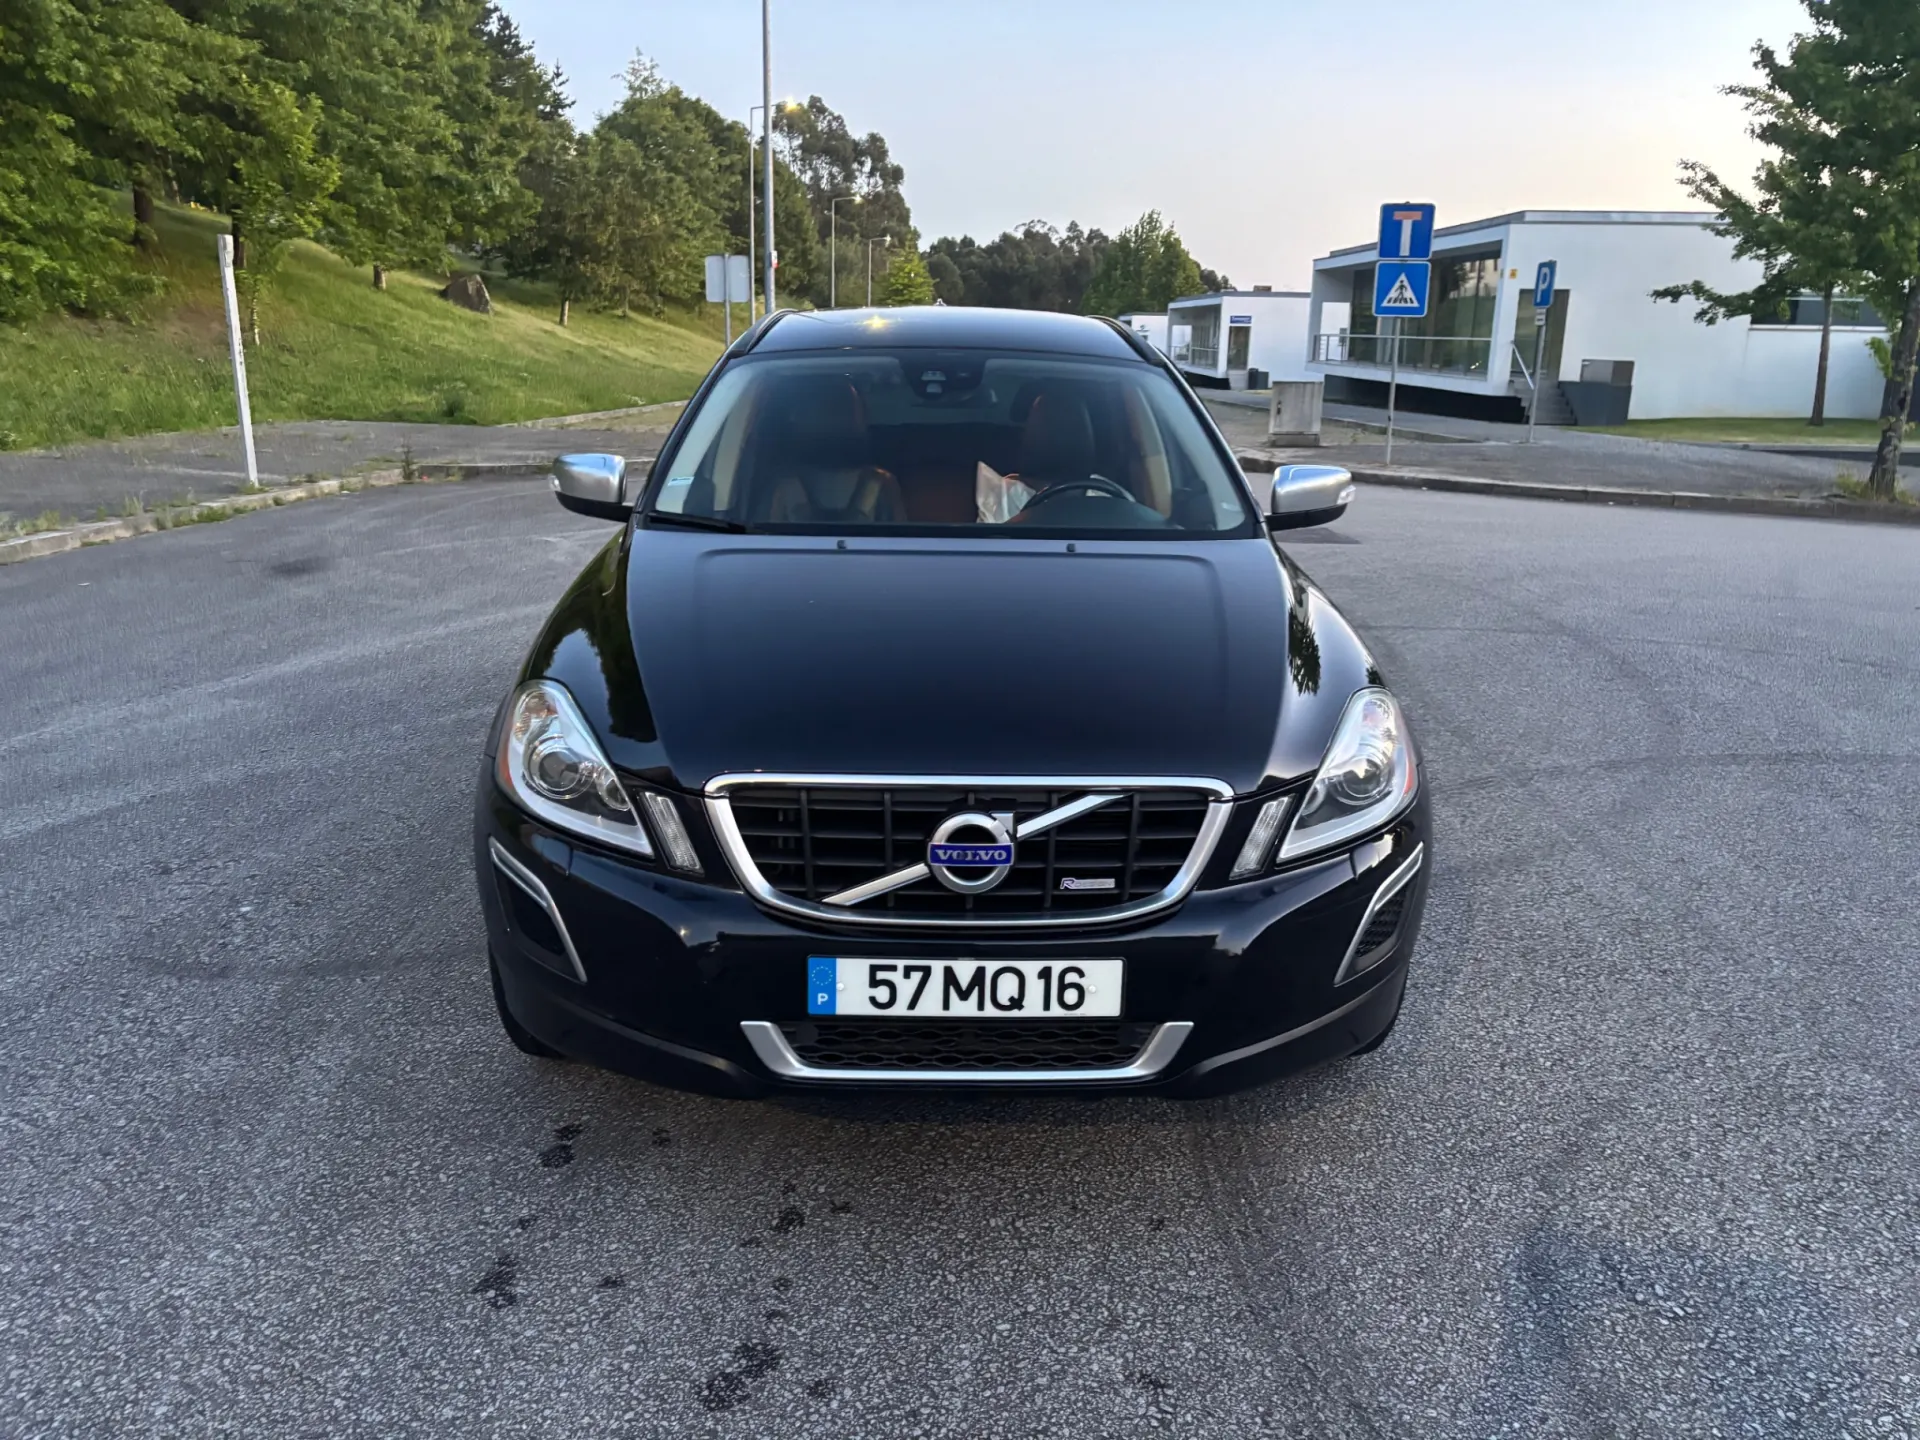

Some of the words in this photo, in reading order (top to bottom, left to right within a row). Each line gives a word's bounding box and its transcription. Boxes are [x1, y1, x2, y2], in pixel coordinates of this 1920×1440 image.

[1536, 267, 1551, 303] P
[933, 849, 1007, 861] VOLVO
[817, 993, 828, 1005] P
